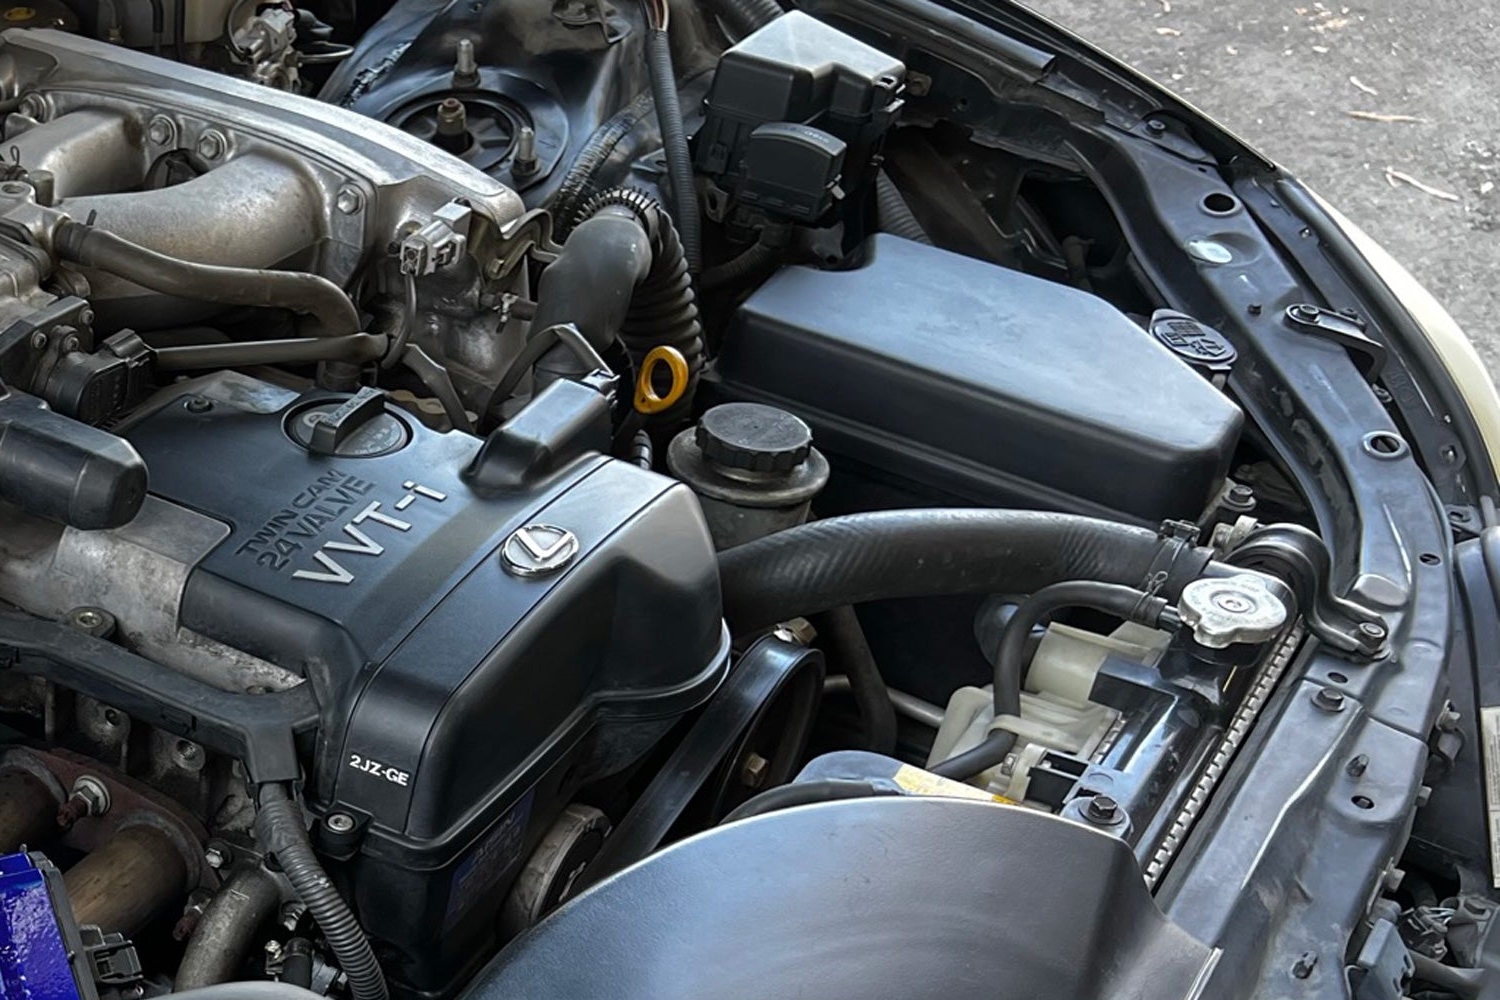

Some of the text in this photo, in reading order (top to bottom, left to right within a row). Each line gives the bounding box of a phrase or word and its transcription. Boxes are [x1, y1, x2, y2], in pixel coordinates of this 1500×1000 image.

[235, 469, 348, 556] TWIN CAM
[256, 475, 377, 573] 24 VALVE
[291, 479, 447, 585] VVT-i
[349, 754, 411, 787] 2JZ-GE
